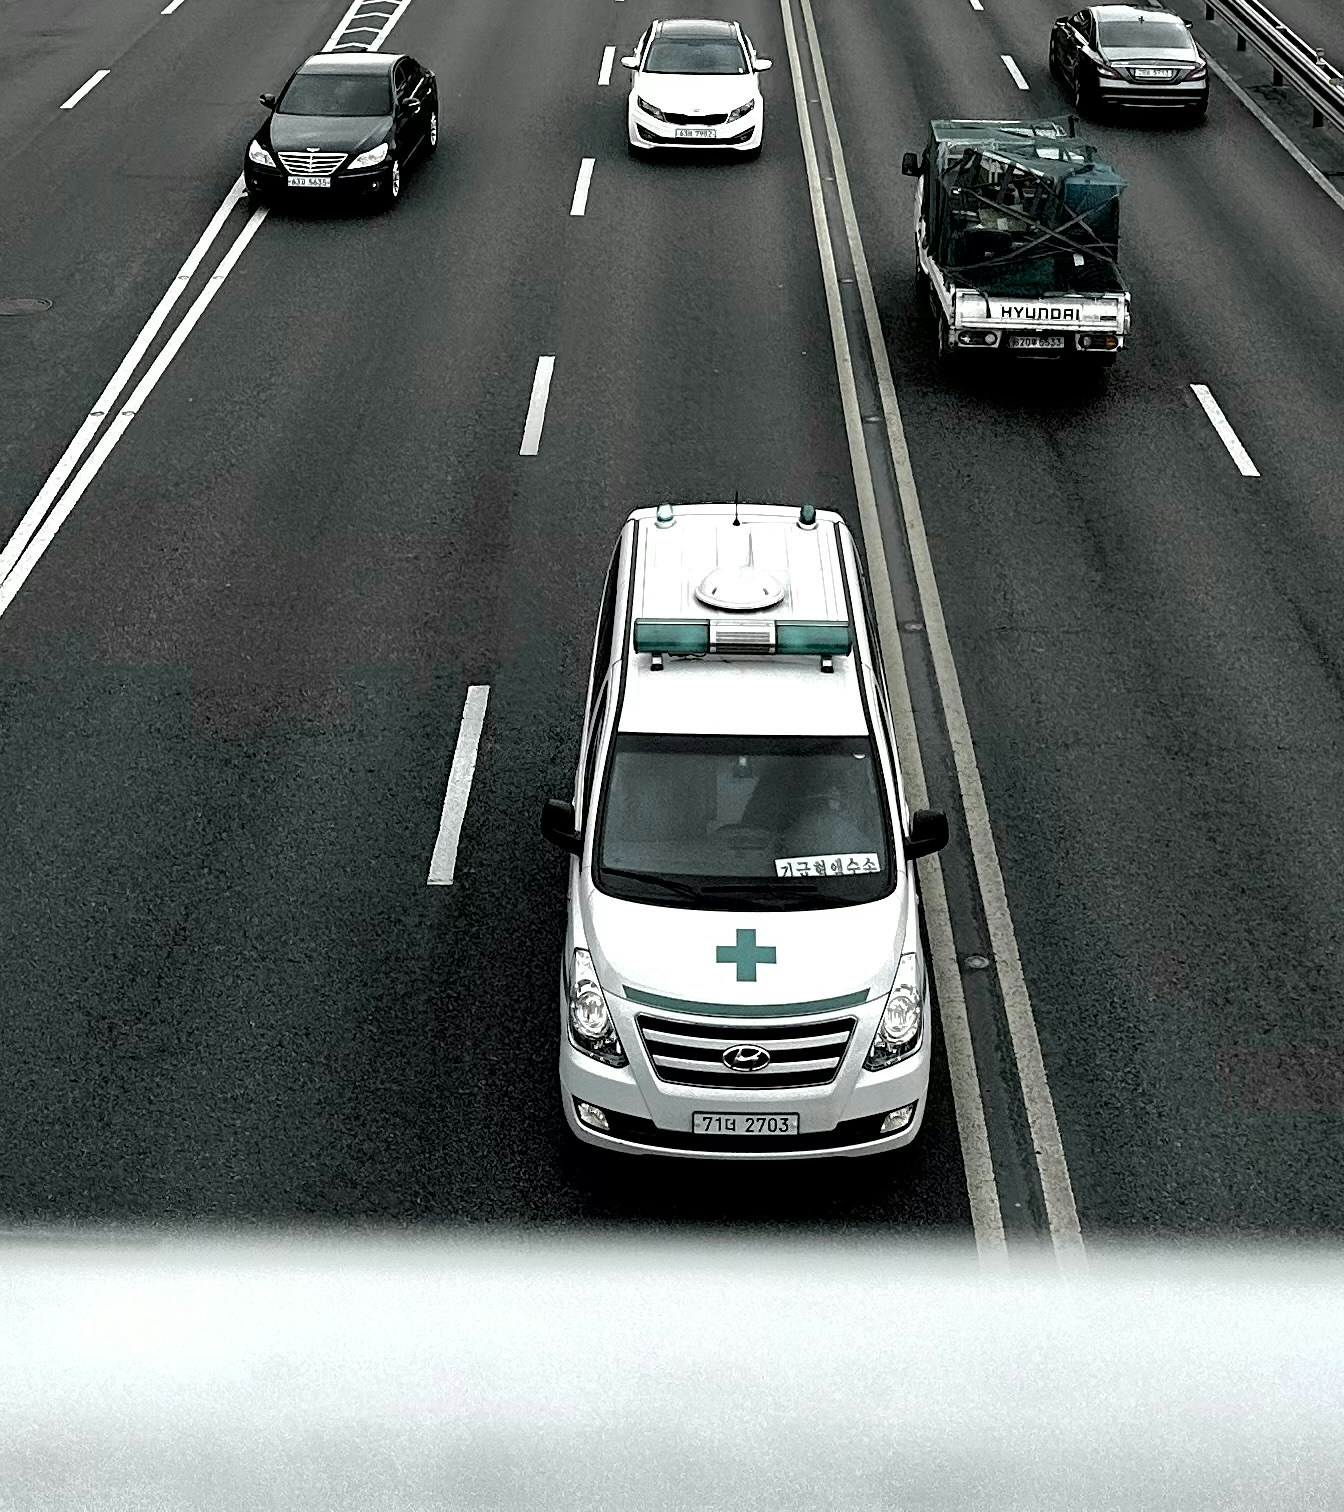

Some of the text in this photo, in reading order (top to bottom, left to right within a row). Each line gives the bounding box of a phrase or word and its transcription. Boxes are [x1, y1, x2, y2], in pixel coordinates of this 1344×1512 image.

[1001, 306, 1080, 321] HYUNDAI
[702, 1116, 789, 1133] 71더 2703
